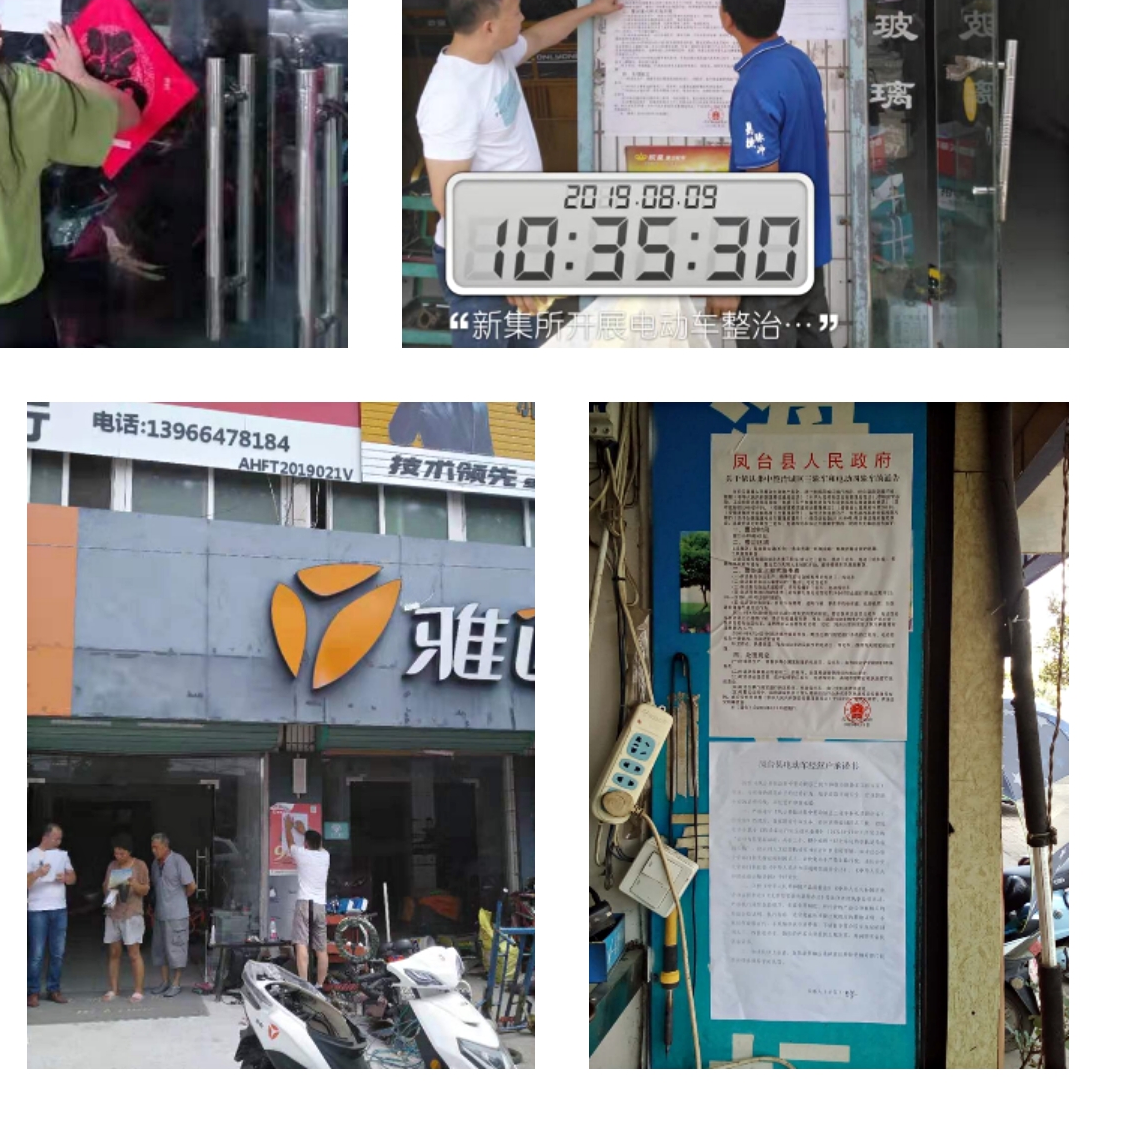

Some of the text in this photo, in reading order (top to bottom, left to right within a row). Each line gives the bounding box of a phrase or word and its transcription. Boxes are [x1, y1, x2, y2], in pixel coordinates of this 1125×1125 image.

[93, 410, 290, 453] 电话:13966478184
[238, 456, 354, 482] AHFT2019021V
[388, 454, 517, 487] 技术领先
[732, 451, 892, 471] 凤台县人民政府
[406, 603, 535, 681] 雅
